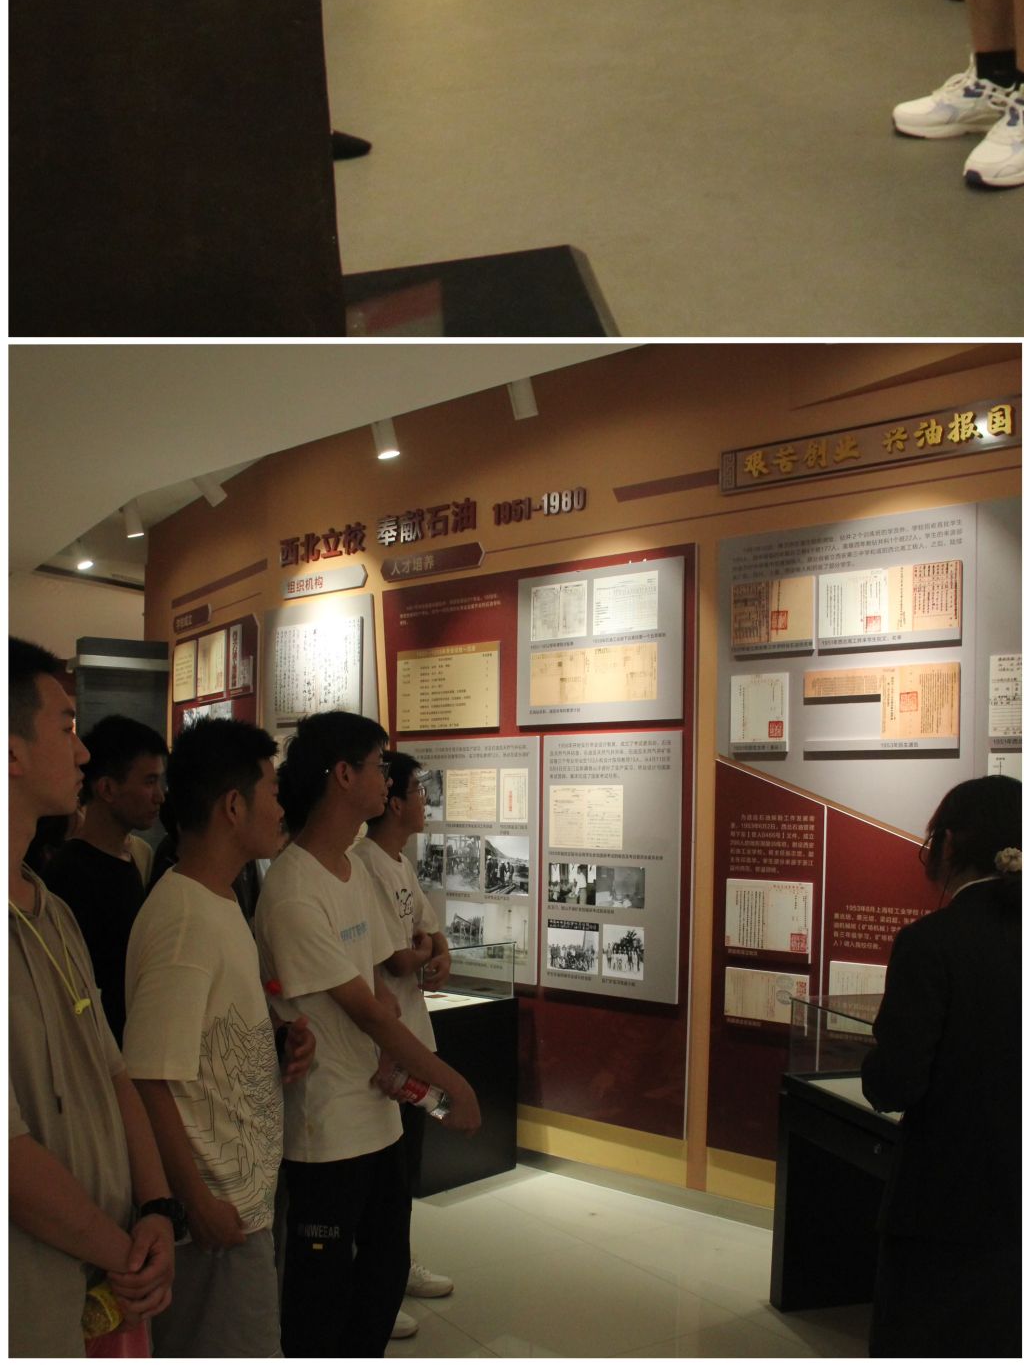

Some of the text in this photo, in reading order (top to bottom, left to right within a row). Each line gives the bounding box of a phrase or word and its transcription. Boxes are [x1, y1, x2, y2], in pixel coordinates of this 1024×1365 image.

[744, 404, 1012, 478] 艰苦创业 兴油报国
[280, 486, 587, 568] 西北立校 奉献石油 1951-1980
[287, 575, 324, 594] 组织机构
[390, 554, 435, 577] 人才培养
